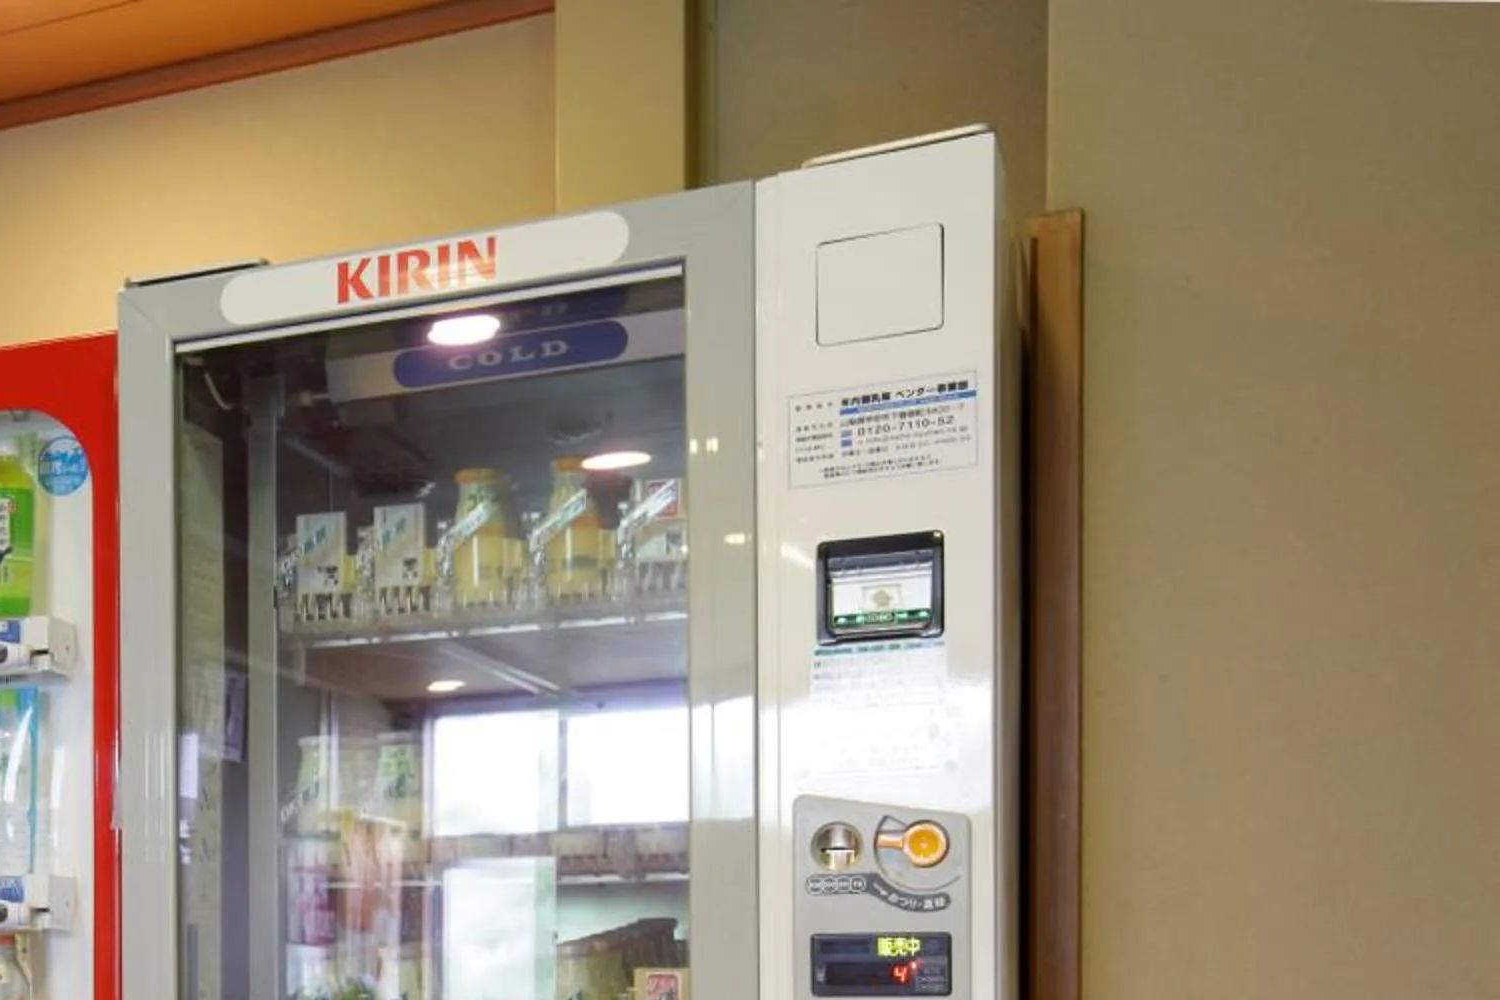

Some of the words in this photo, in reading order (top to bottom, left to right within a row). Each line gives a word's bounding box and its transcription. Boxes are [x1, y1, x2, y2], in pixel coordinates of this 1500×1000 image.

[337, 236, 498, 304] KIRIN
[447, 340, 569, 371] COLD
[877, 937, 921, 957] 販売中
